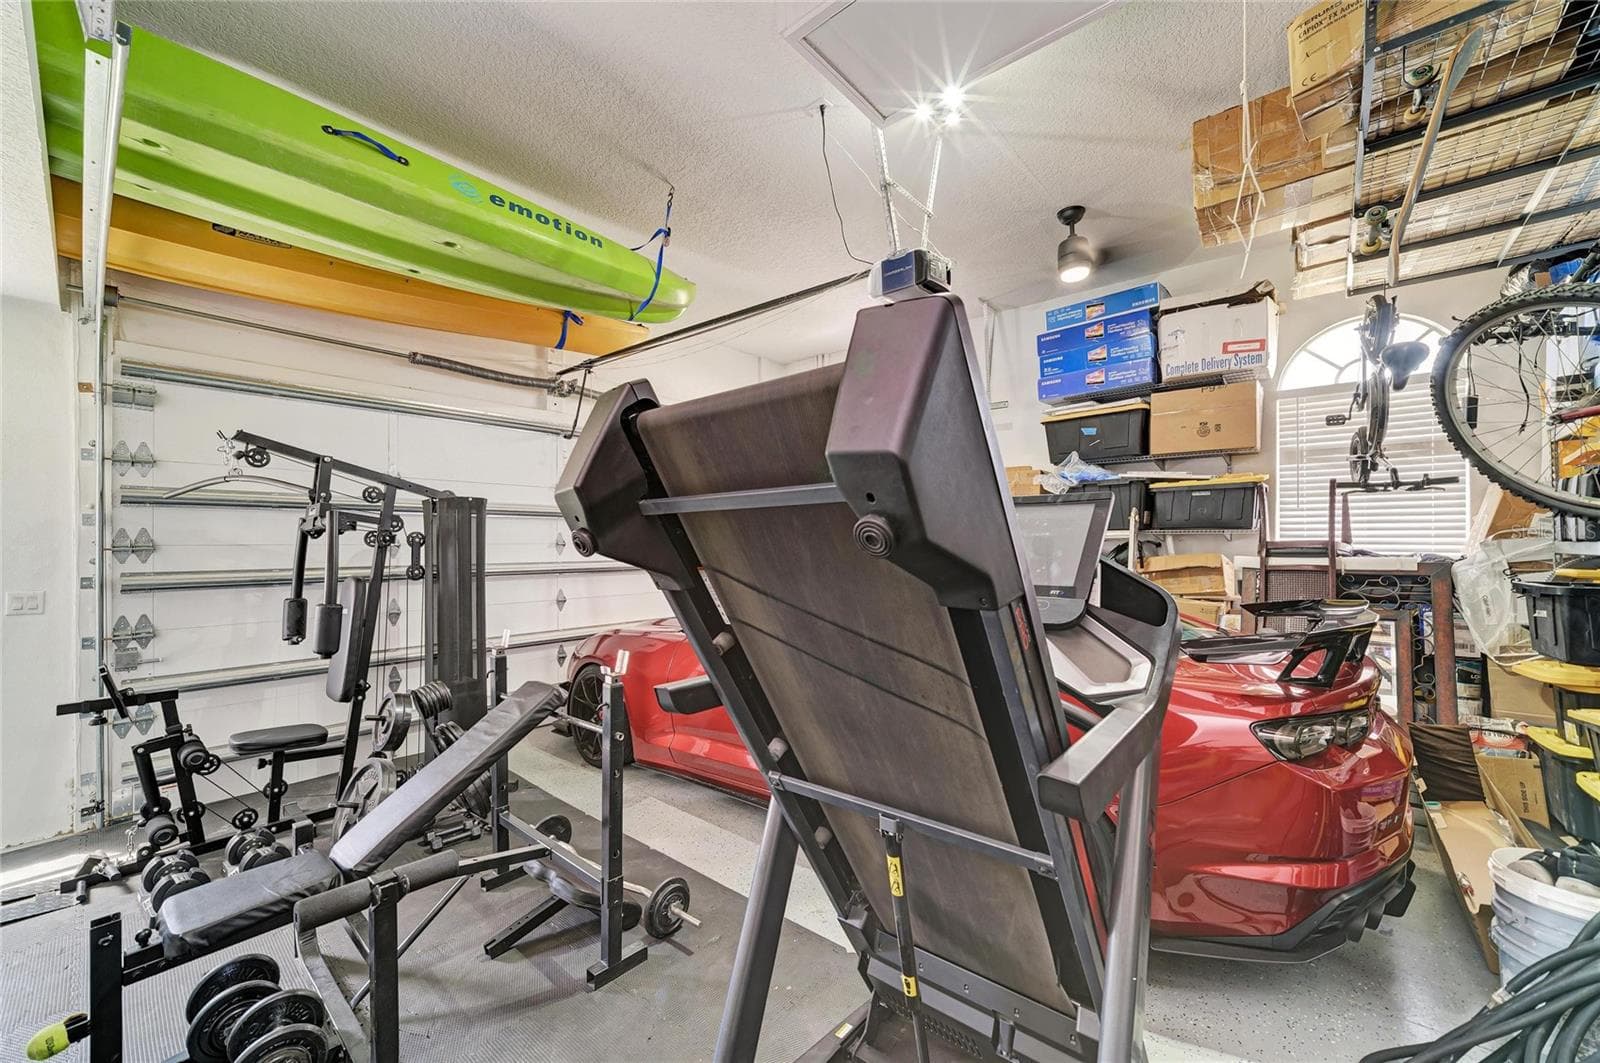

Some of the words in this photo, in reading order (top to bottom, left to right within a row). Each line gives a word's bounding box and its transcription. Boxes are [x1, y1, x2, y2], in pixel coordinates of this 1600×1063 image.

[489, 194, 603, 249] emotion
[1166, 361, 1200, 377] Complete
[1201, 356, 1233, 372] Delivery
[1234, 353, 1263, 368] System
